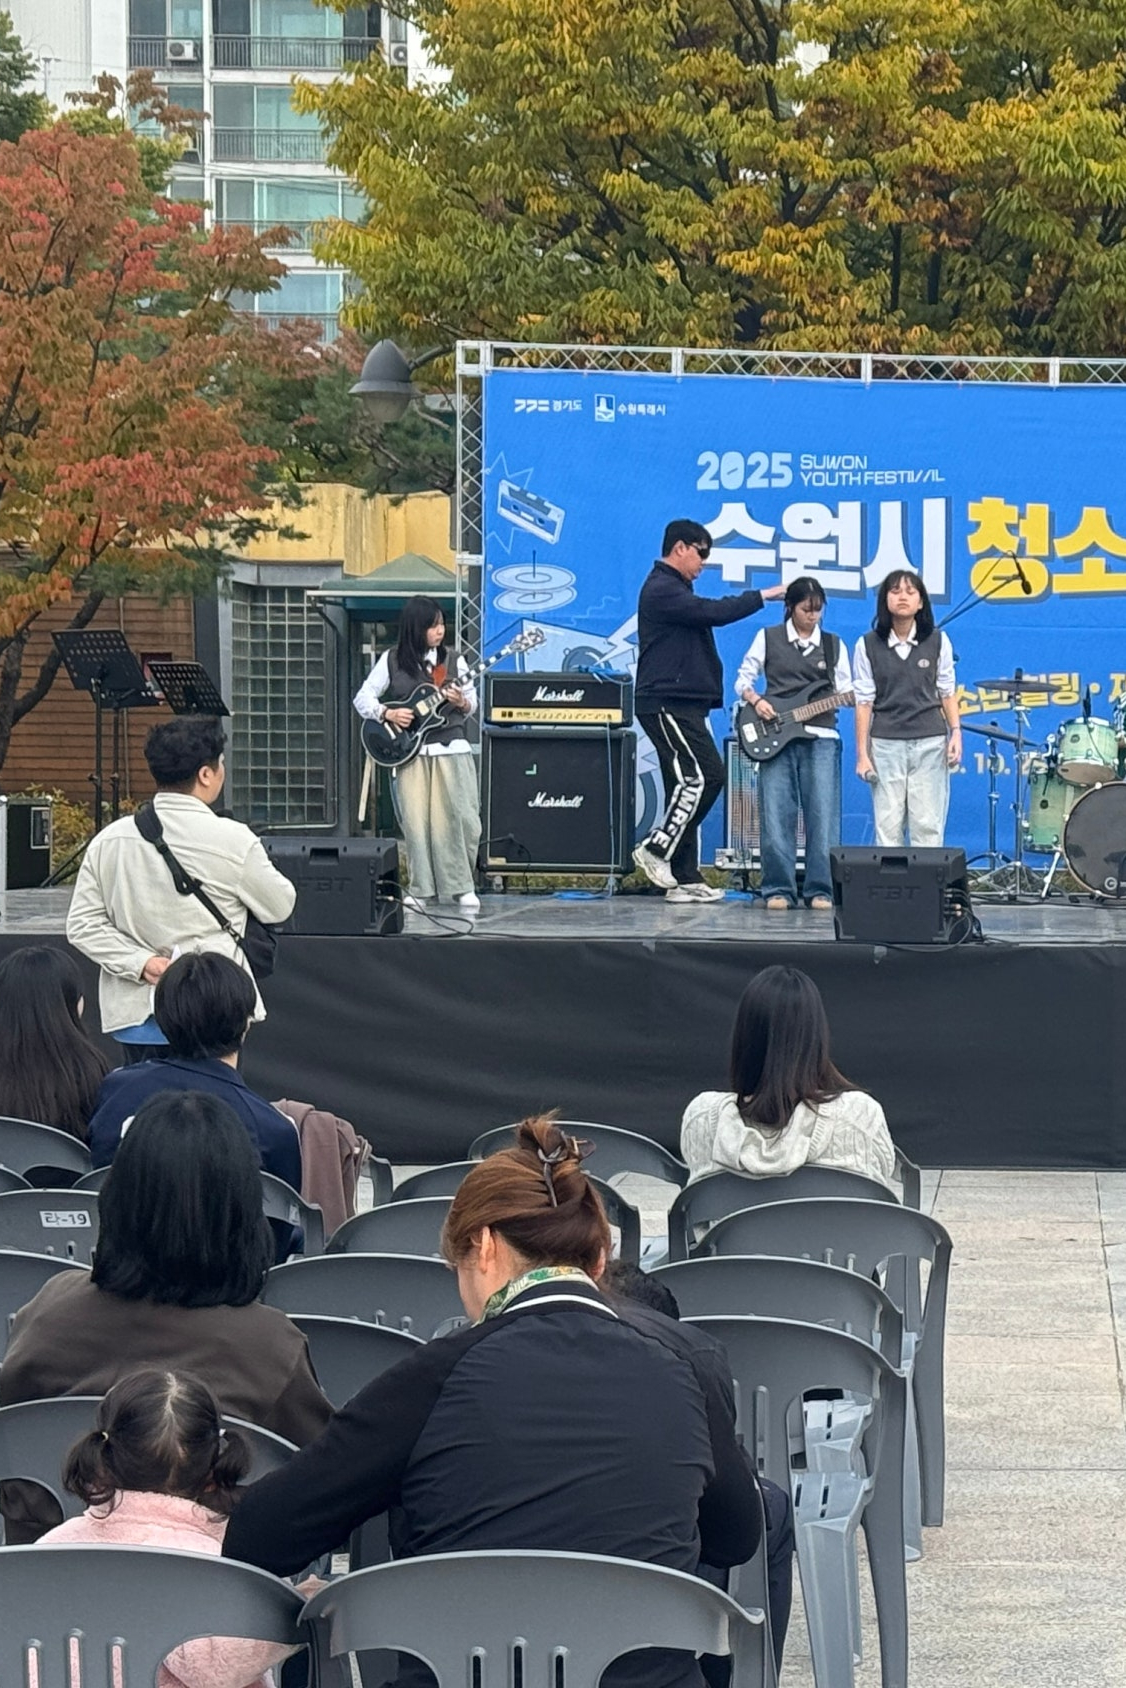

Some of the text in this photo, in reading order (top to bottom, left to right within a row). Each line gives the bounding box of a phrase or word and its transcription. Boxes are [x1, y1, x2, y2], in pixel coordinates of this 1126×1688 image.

[697, 451, 868, 491] 2025 SUWON
[800, 471, 862, 487] YOUTH
[703, 497, 947, 595] 수원시
[532, 685, 585, 702] Marshall
[528, 792, 584, 809] Marshall
[297, 877, 354, 892] FBT
[866, 885, 921, 900] FBT
[44, 1212, 88, 1226] 라-19
